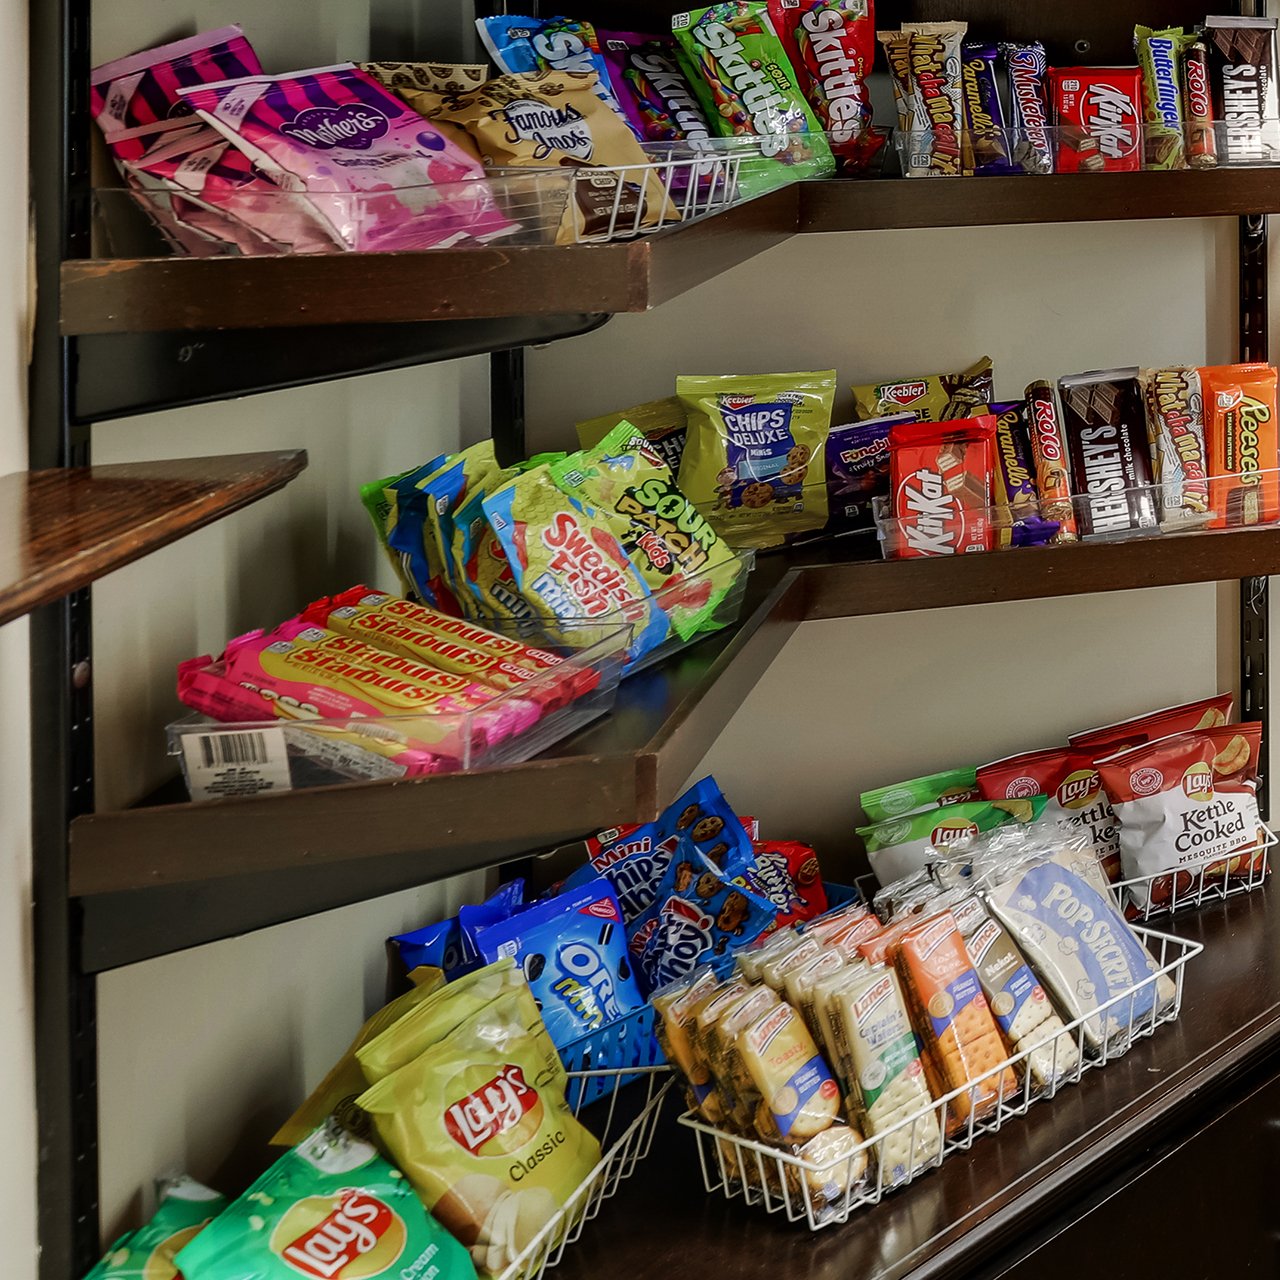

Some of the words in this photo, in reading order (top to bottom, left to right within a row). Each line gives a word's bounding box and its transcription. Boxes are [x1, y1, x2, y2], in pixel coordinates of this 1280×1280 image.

[802, 8, 861, 143] Skittles
[1149, 37, 1182, 132] Butterfinger
[495, 102, 588, 146] Famous
[1013, 67, 1049, 151] Musketeers
[286, 110, 385, 152] Mother's
[886, 383, 925, 400] Keebler
[733, 428, 789, 446] DELUXE
[1121, 423, 1134, 462] chocolate
[1235, 394, 1271, 486] Reese's
[1080, 423, 1133, 535] HERSHEY'S
[1123, 461, 1137, 482] milk
[542, 511, 647, 622] Swedish
[386, 600, 523, 655] Starburst
[1060, 774, 1099, 806] Lay's
[1186, 768, 1213, 797] Lay's
[1173, 812, 1247, 854] Cooked
[1181, 799, 1237, 834] Kettle
[590, 836, 653, 874] Mini
[1178, 843, 1228, 865] MESQUITE
[1229, 835, 1248, 851] BBQ
[853, 977, 891, 1020] Lance
[448, 1065, 530, 1151] Lay's
[507, 1128, 567, 1184] Classic
[284, 1193, 381, 1280] Lay's
